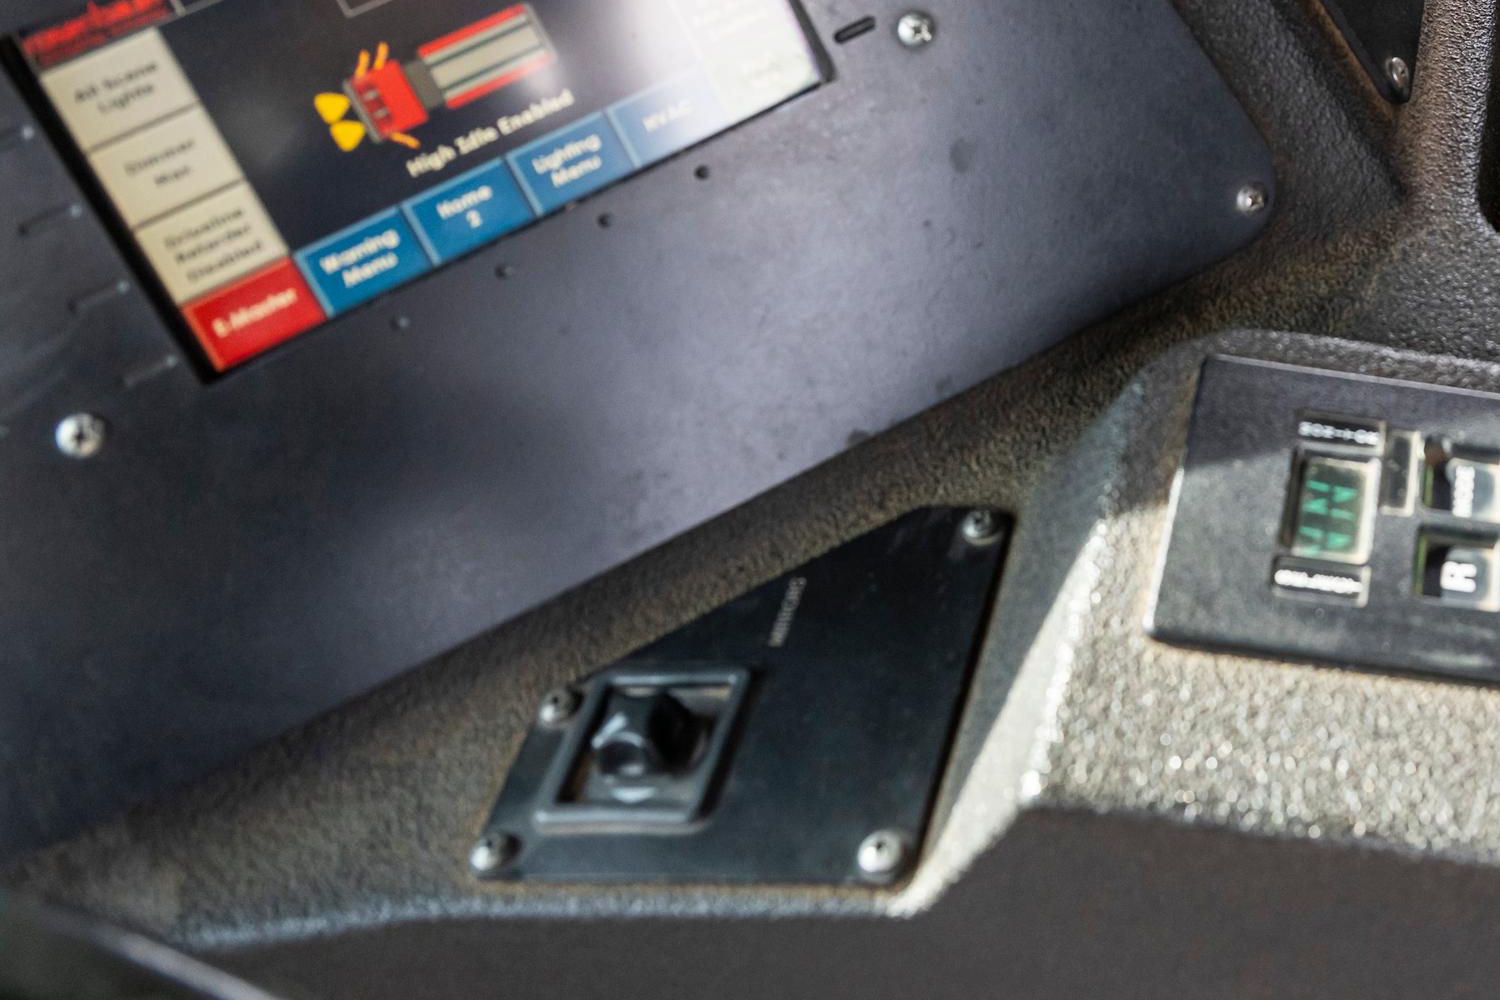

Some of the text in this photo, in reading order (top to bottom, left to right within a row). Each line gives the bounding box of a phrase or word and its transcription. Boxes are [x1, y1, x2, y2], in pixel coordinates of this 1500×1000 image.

[407, 89, 575, 178] High Idle Enabled
[532, 133, 602, 178] Lighting
[550, 154, 602, 187] Menu
[437, 184, 493, 219] Home
[468, 211, 482, 228] 2
[319, 230, 400, 274] Warning
[341, 252, 399, 287] Menu
[1441, 561, 1477, 592] R
